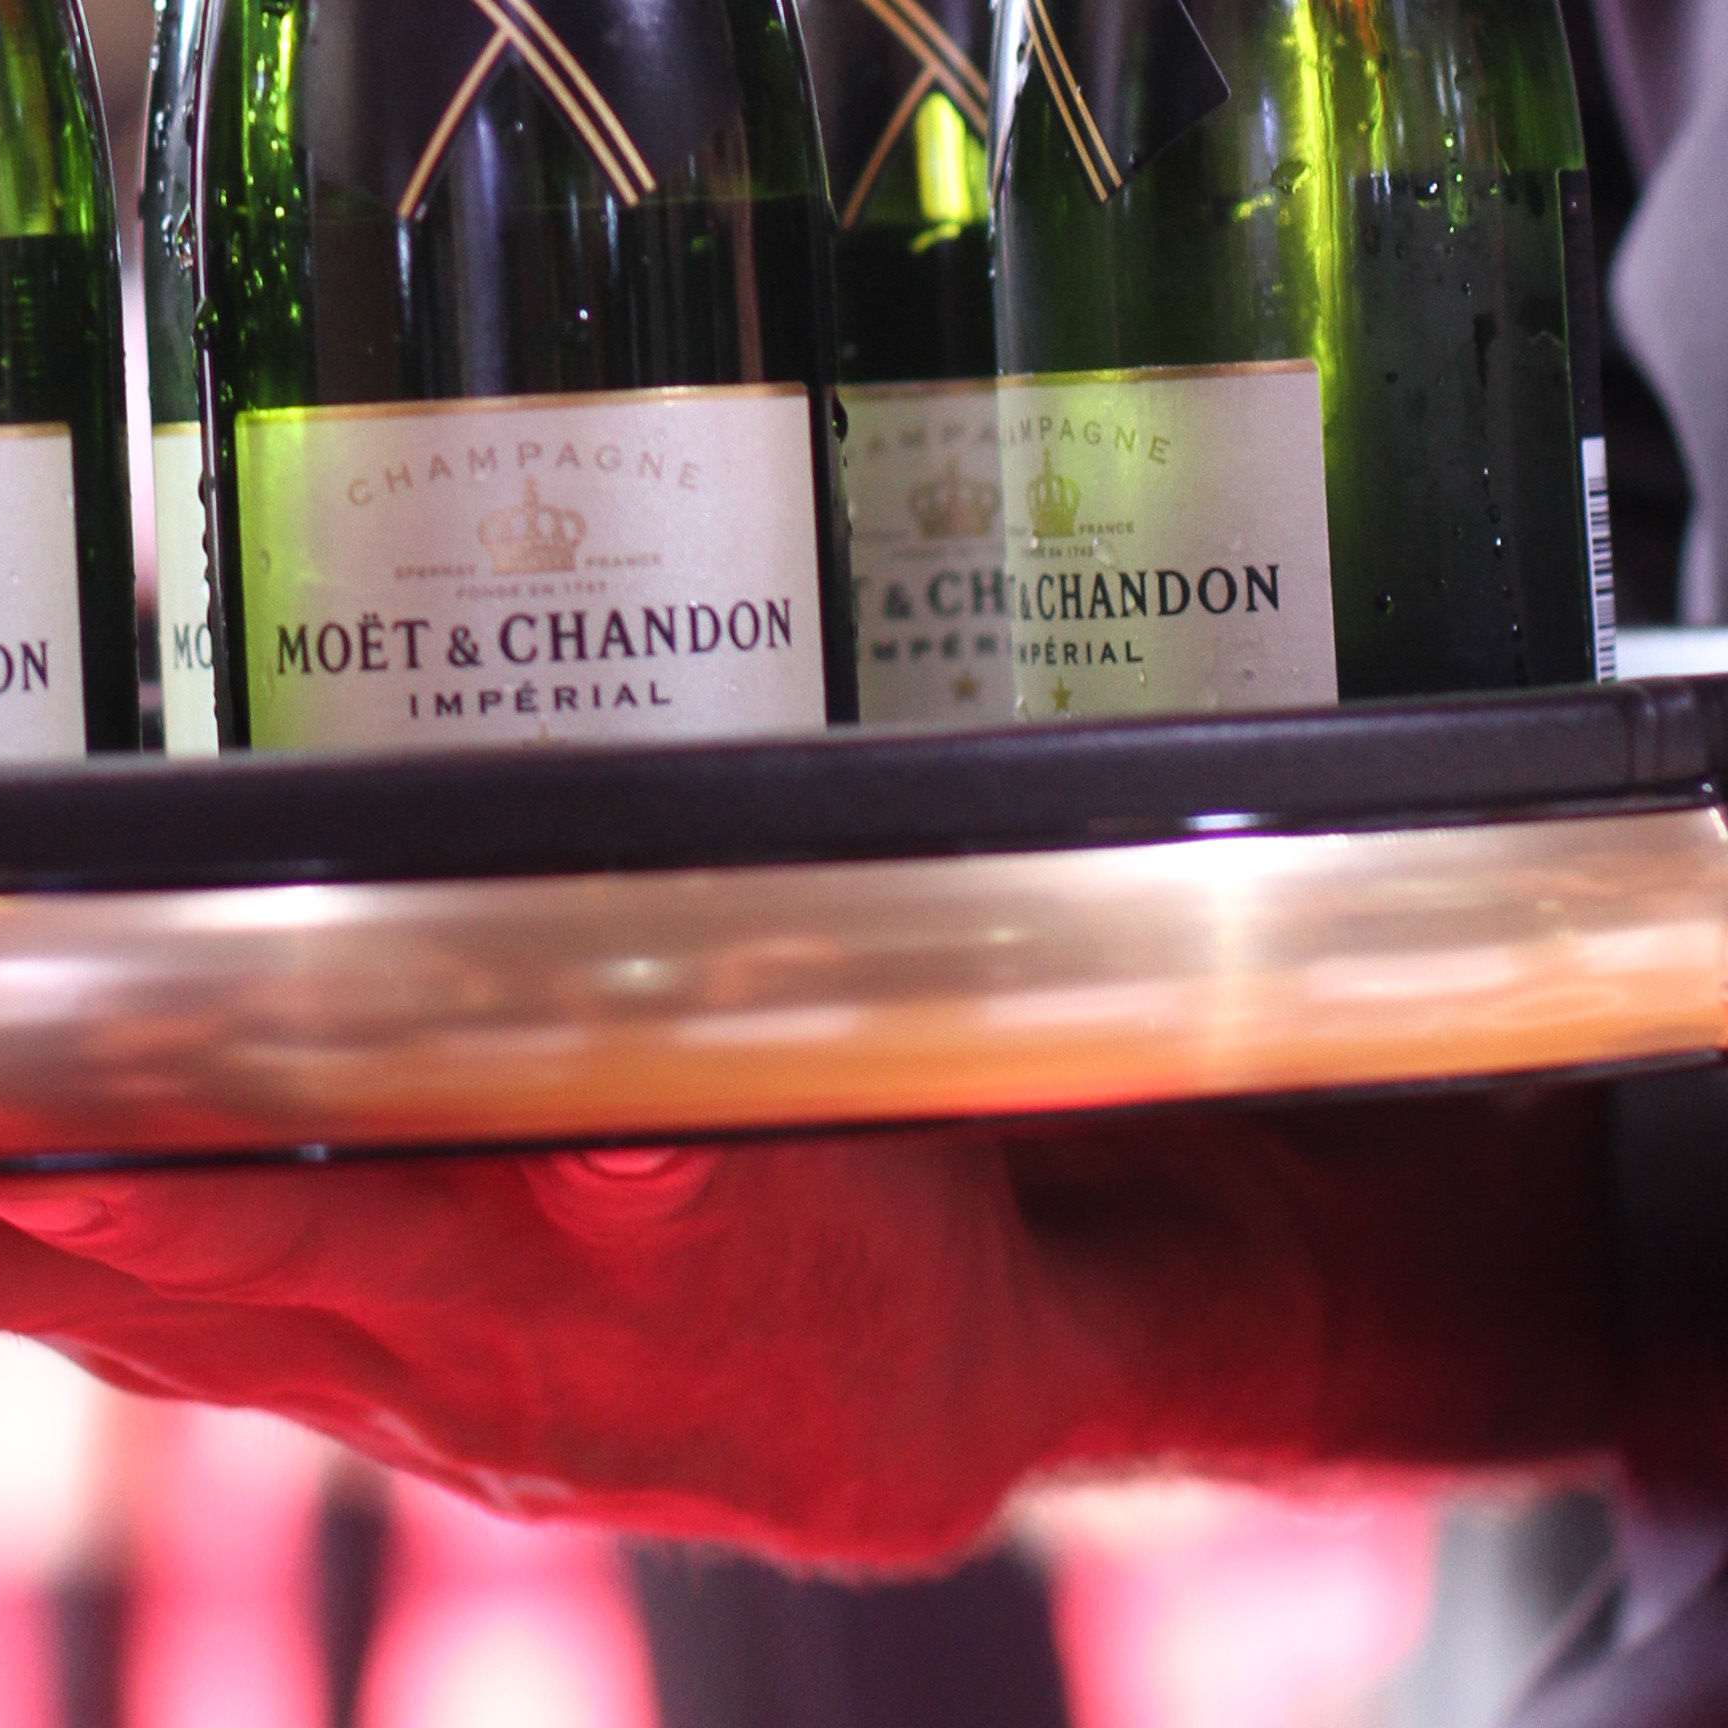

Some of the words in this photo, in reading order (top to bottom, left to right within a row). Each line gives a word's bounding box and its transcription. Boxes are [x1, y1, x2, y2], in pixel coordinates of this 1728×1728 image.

[348, 441, 703, 508] CHAMPAGNE
[1036, 564, 1279, 621] CHANDON
[173, 623, 213, 669] MO
[276, 611, 430, 676] MOËT
[448, 626, 483, 667] &
[499, 597, 793, 663] CHANDON
[1019, 637, 1144, 666] MPÉRIAL
[409, 679, 672, 720] IMPÉRIAL
